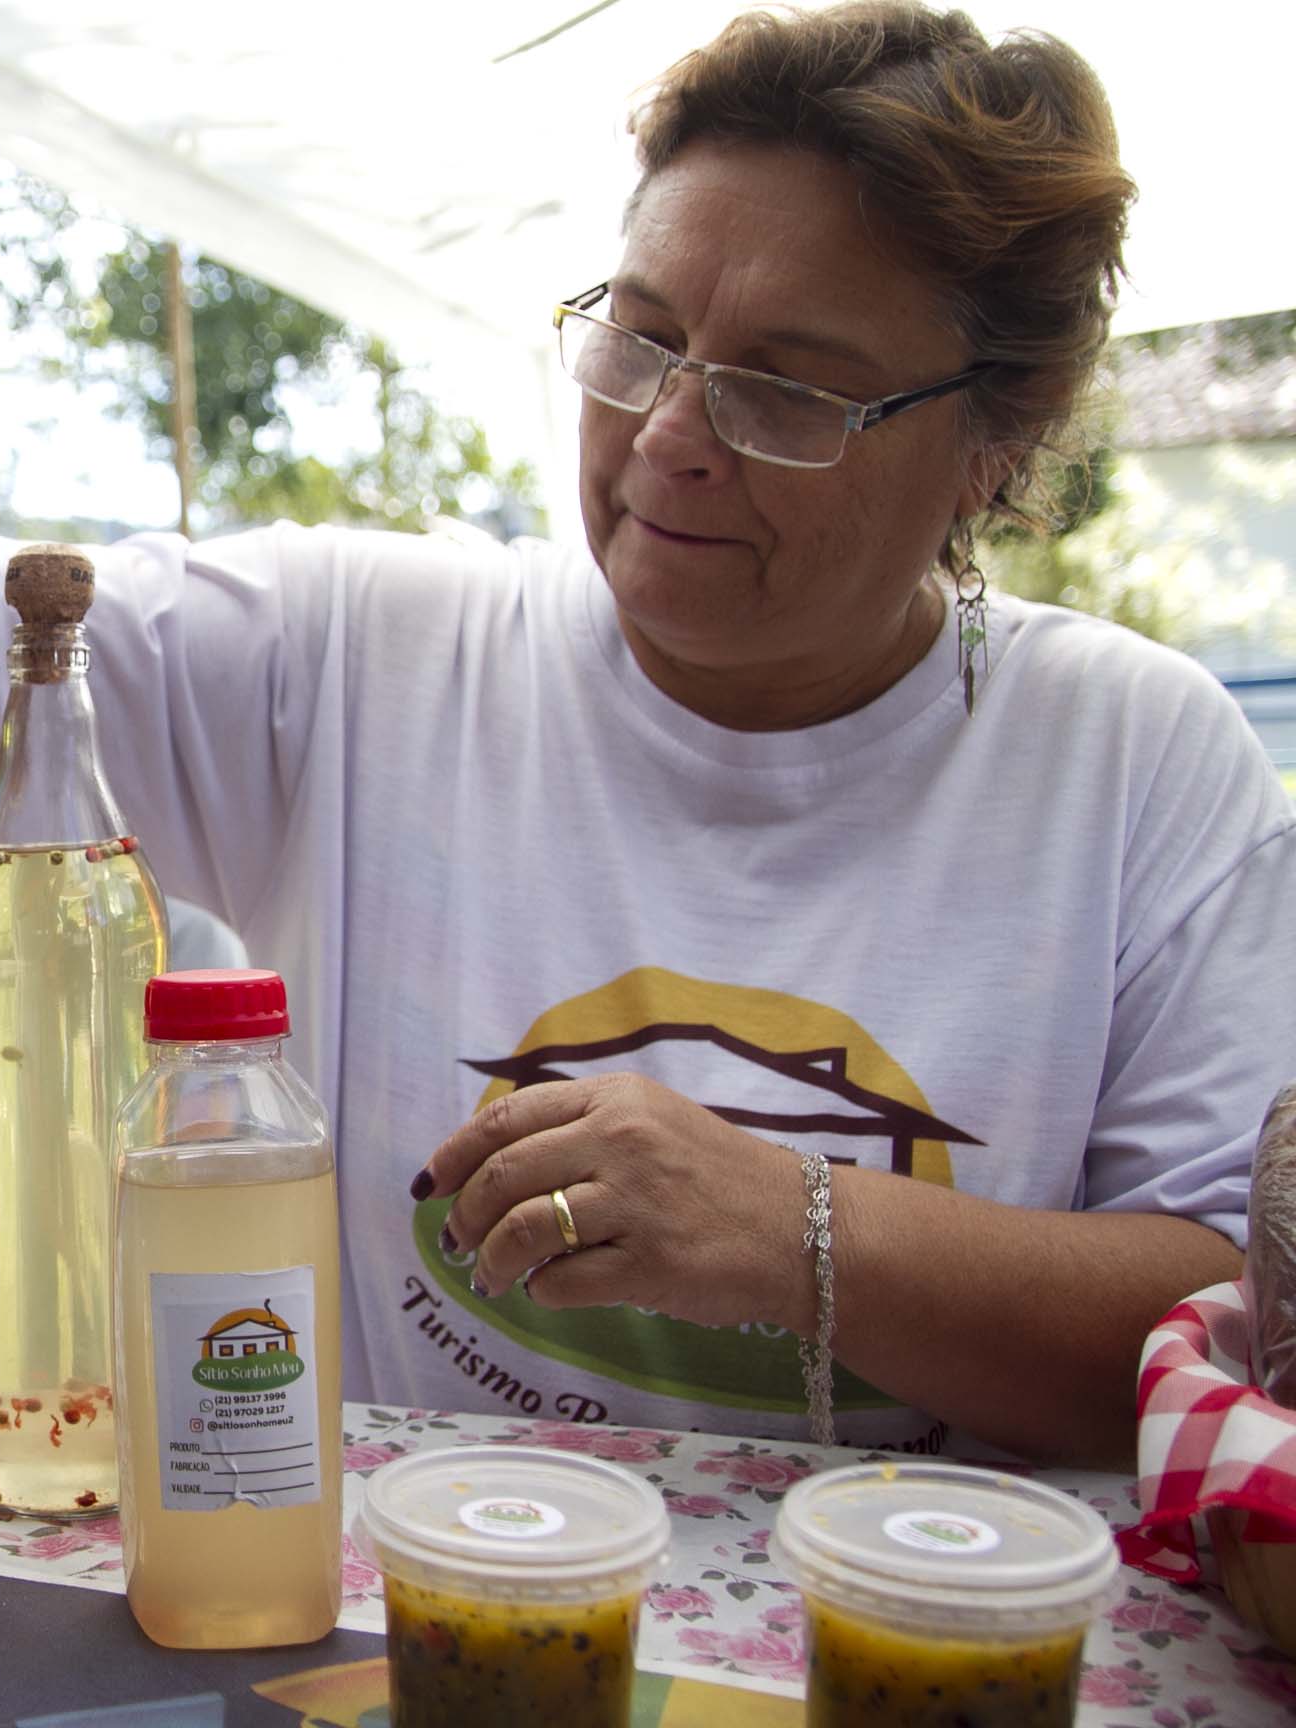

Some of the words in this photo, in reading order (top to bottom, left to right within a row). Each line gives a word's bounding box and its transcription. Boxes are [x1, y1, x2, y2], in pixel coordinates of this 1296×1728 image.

[401, 1275, 542, 1414] Turismo
[231, 1364, 272, 1380] Sonho
[273, 1362, 300, 1376] Meu
[214, 1395, 232, 1406] (21)
[233, 1394, 261, 1404] 99137
[263, 1391, 286, 1401] 3996
[215, 1408, 232, 1418] (21)
[233, 1407, 264, 1417] 97029
[266, 1405, 285, 1414] 1217
[207, 1416, 294, 1432] @sitiosonhomeu2
